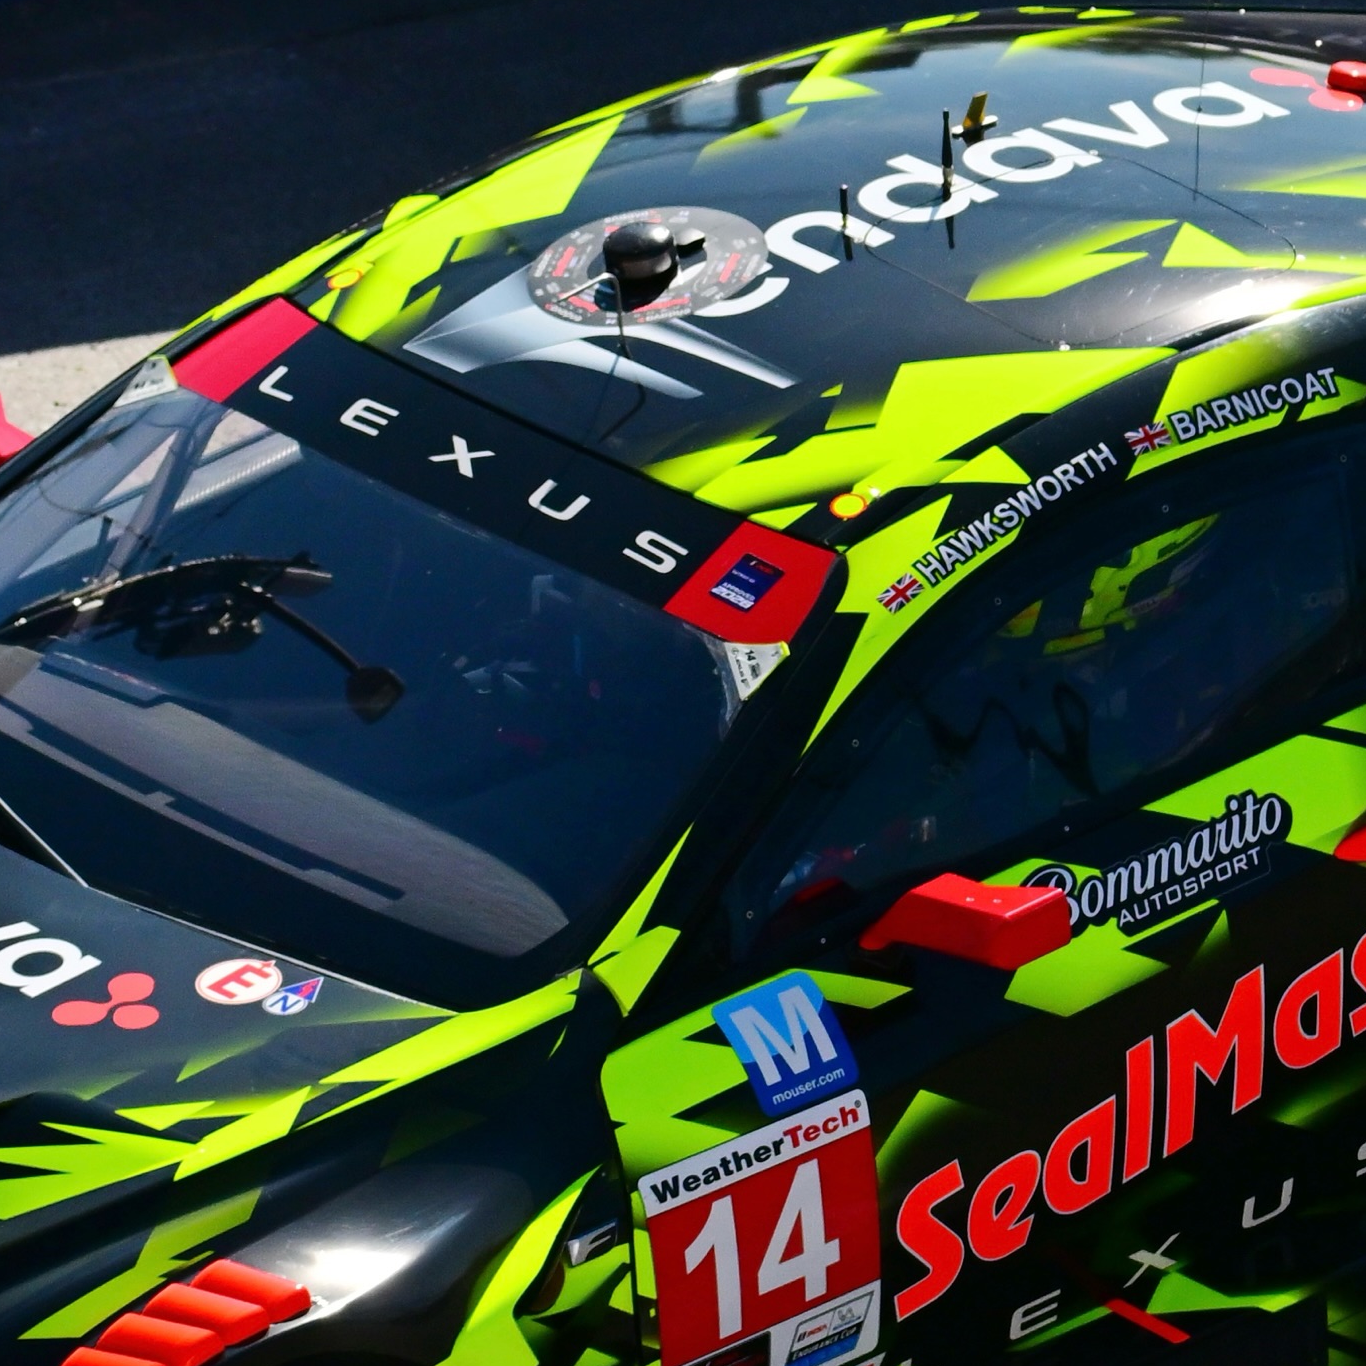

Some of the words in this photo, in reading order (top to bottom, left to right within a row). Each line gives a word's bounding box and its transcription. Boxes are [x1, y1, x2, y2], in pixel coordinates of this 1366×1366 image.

[1172, 367, 1337, 441] BARNICOAT
[259, 365, 690, 574] LEXUS
[916, 441, 1117, 584] HAWKSWORTH
[1119, 846, 1261, 928] AUTOSPORT
[771, 1066, 845, 1106] mouser.com
[650, 1104, 859, 1205] WeatherTech
[684, 1158, 840, 1340] 14
